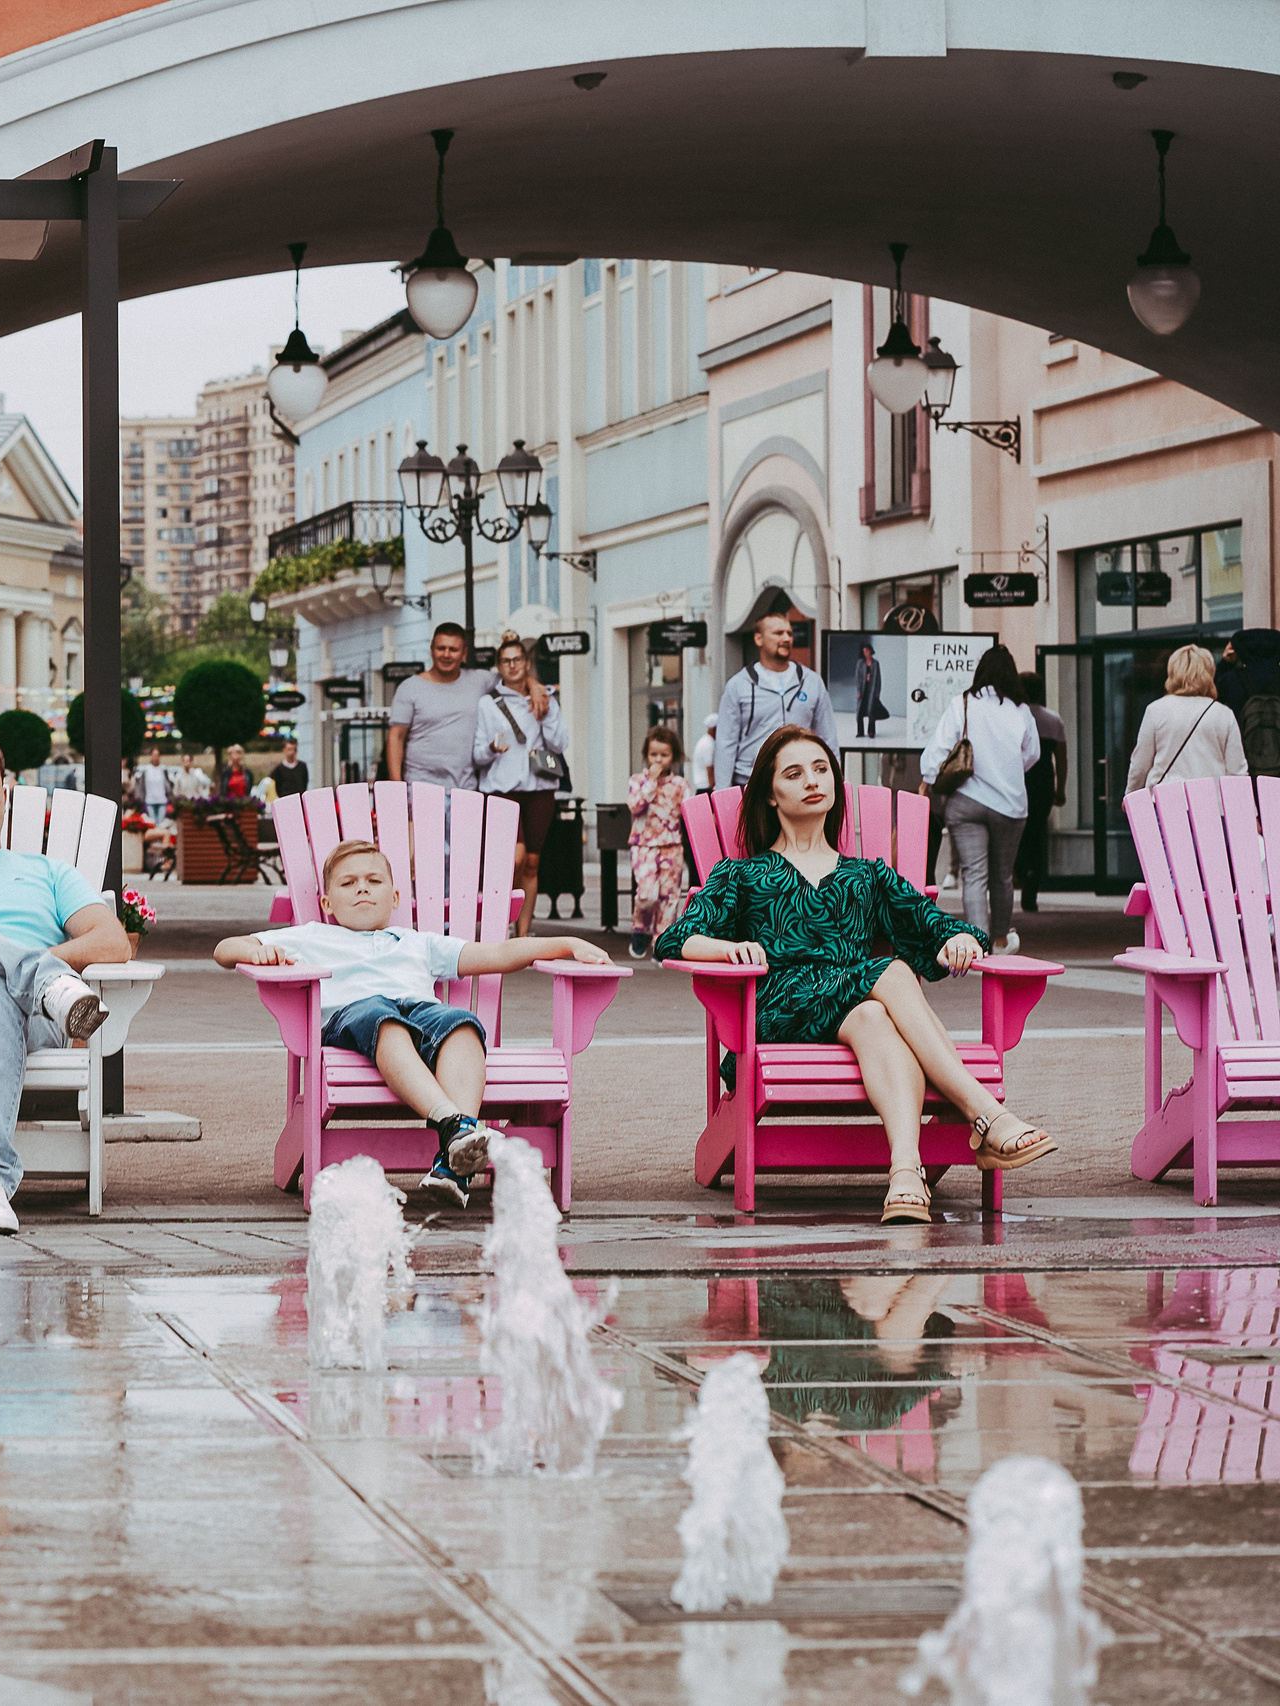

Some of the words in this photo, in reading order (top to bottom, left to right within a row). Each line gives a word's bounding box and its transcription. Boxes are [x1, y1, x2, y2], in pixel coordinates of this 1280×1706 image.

[545, 635, 583, 652] VANS
[933, 643, 968, 656] FINN
[926, 659, 975, 672] FLARE
